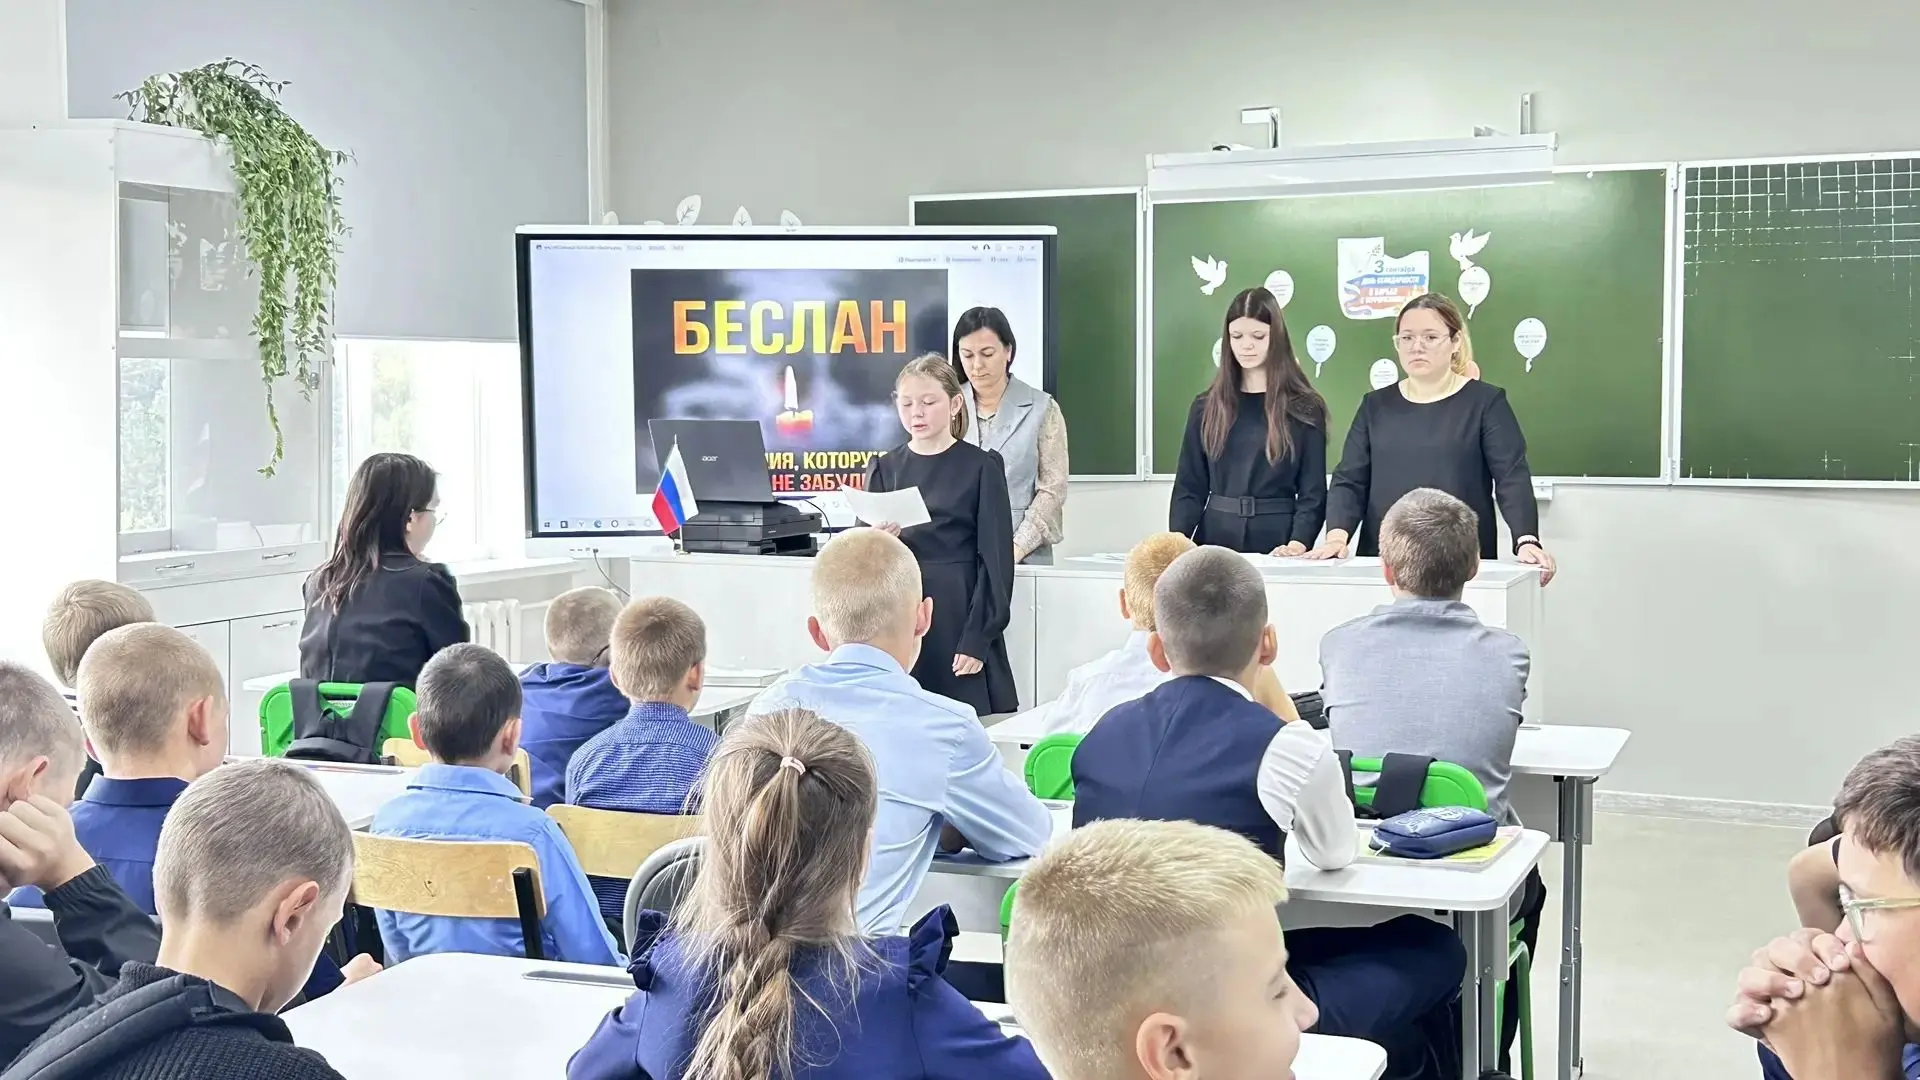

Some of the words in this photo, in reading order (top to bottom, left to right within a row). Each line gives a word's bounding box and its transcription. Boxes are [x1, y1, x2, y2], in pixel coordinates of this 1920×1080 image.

[1374, 260, 1384, 273] 3
[673, 300, 907, 355] БЕСЛАН
[803, 451, 888, 469] КОТОРУ
[772, 474, 795, 491] НЕ
[800, 473, 866, 491] ЗАБУД
